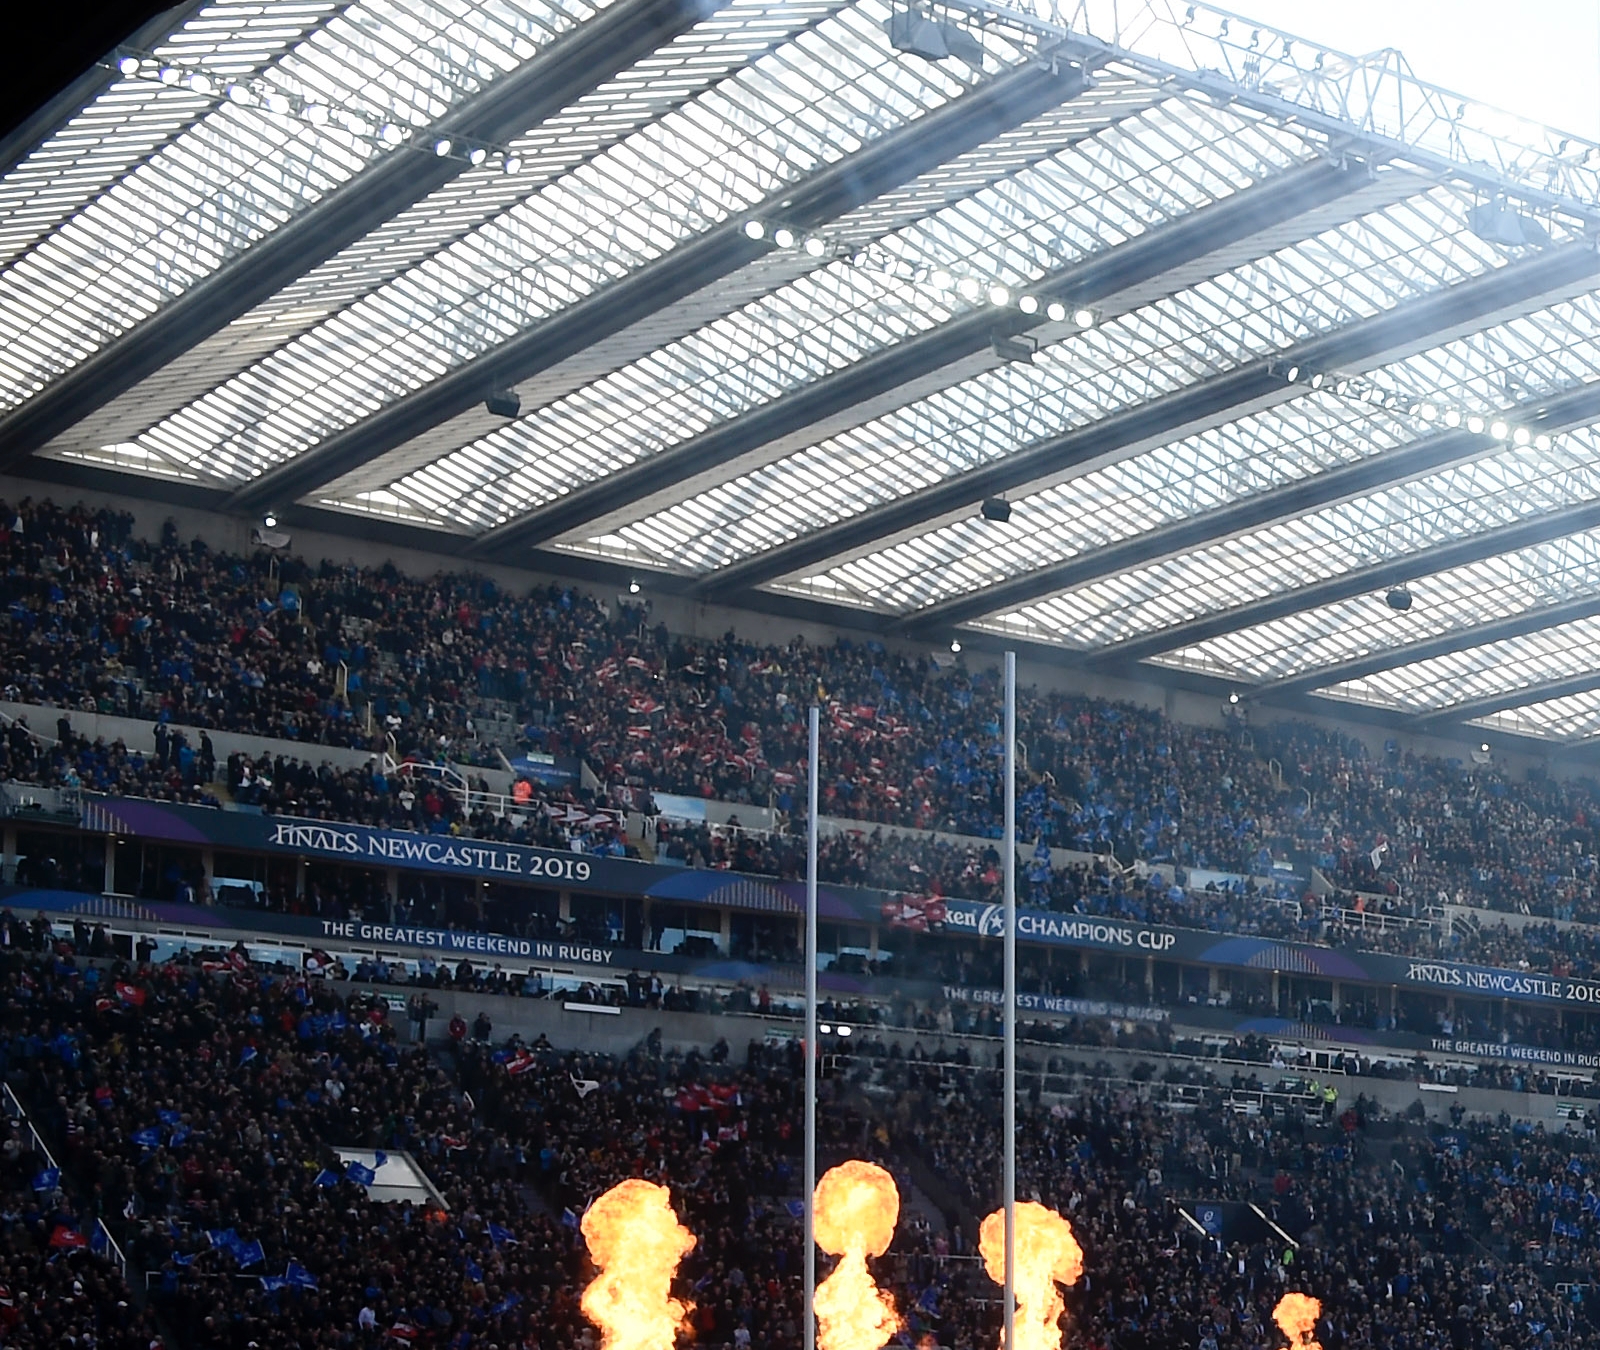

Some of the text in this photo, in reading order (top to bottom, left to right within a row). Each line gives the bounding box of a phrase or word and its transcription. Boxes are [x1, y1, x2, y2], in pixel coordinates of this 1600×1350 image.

[269, 824, 591, 882] FINALS NEWCASTLE 2019
[322, 922, 613, 964] THE GREATEST WEEKEND IN RUGBY
[1018, 916, 1177, 950] CHAMPIONS CUP
[942, 986, 969, 1001] THE
[973, 989, 1039, 1008] GREEST
[1406, 964, 1462, 986] FINALS
[1465, 971, 1561, 998] NEWCASTLE
[1431, 1038, 1452, 1052] THE
[1455, 1041, 1508, 1057] GREATEST
[1511, 1047, 1561, 1062] WEEKEND
[1564, 1052, 1575, 1064] IN
